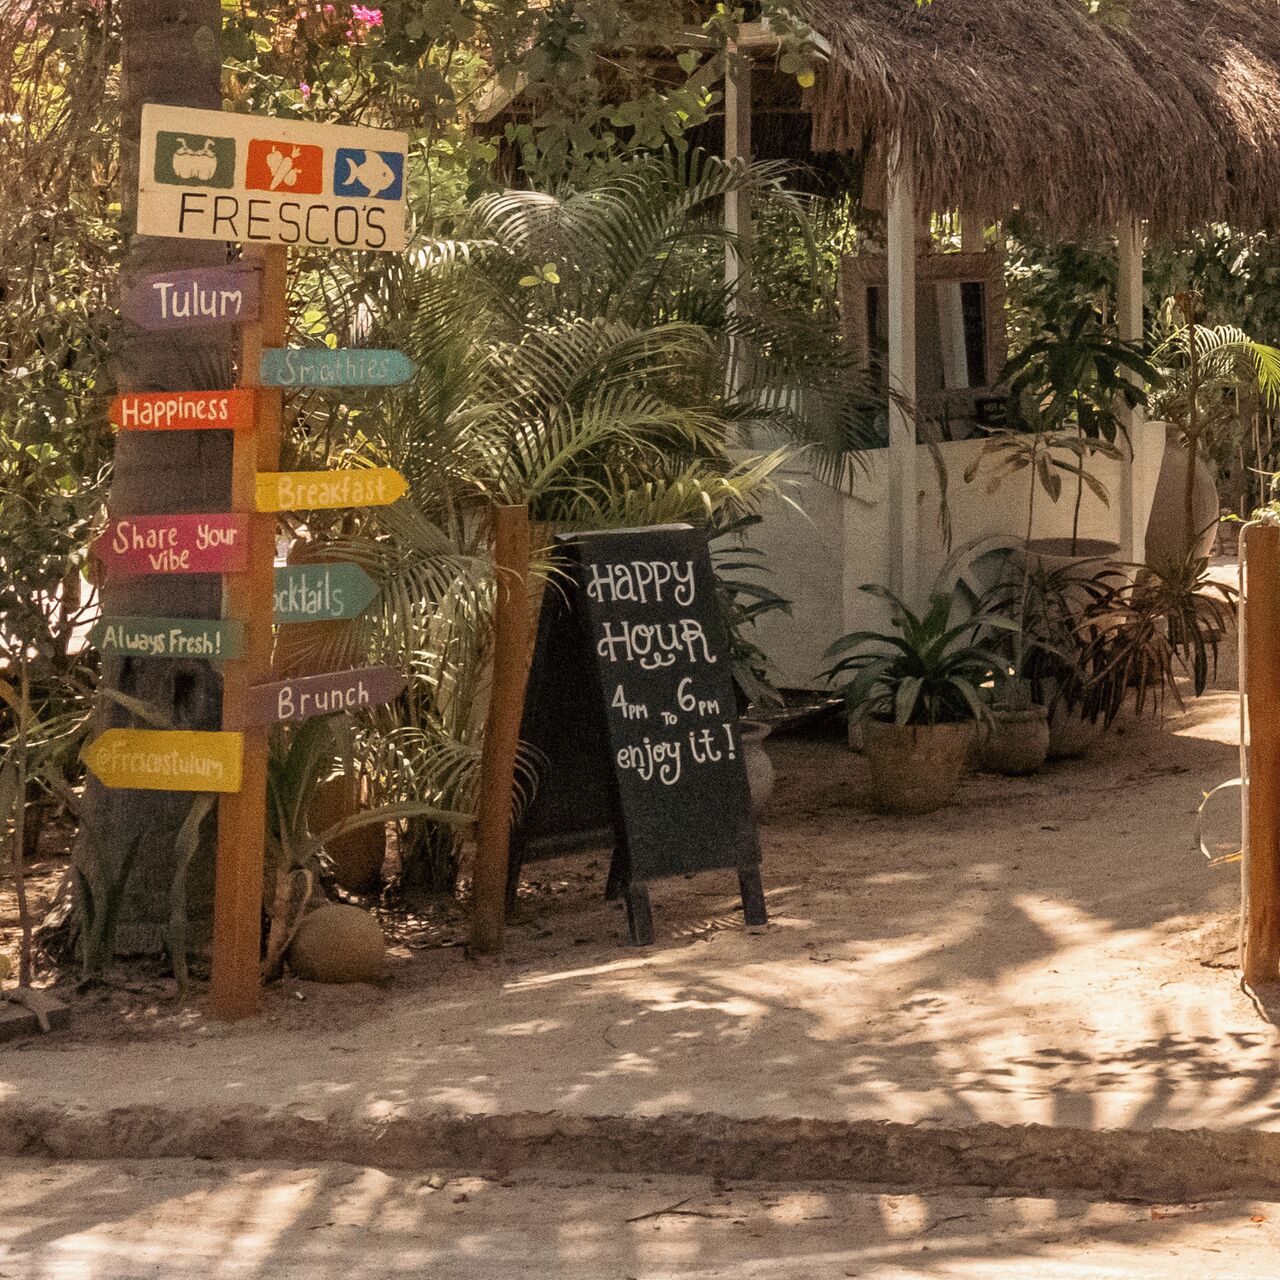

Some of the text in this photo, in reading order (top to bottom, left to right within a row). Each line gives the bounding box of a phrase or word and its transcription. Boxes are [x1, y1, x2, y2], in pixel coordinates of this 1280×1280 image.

[179, 192, 387, 249] FRESCO'S
[153, 281, 242, 318] Tulum
[276, 349, 390, 385] Smoothies
[121, 397, 228, 426] Happiness
[278, 475, 386, 509] Breakfast
[113, 521, 177, 555] Share
[148, 549, 190, 571] vibe
[272, 570, 344, 616] ocktails
[102, 625, 221, 655] Always Fresh!
[597, 619, 717, 664] HOUR
[278, 681, 369, 719] Brunch
[661, 711, 678, 726] TO
[617, 723, 736, 785] enjoy it!
